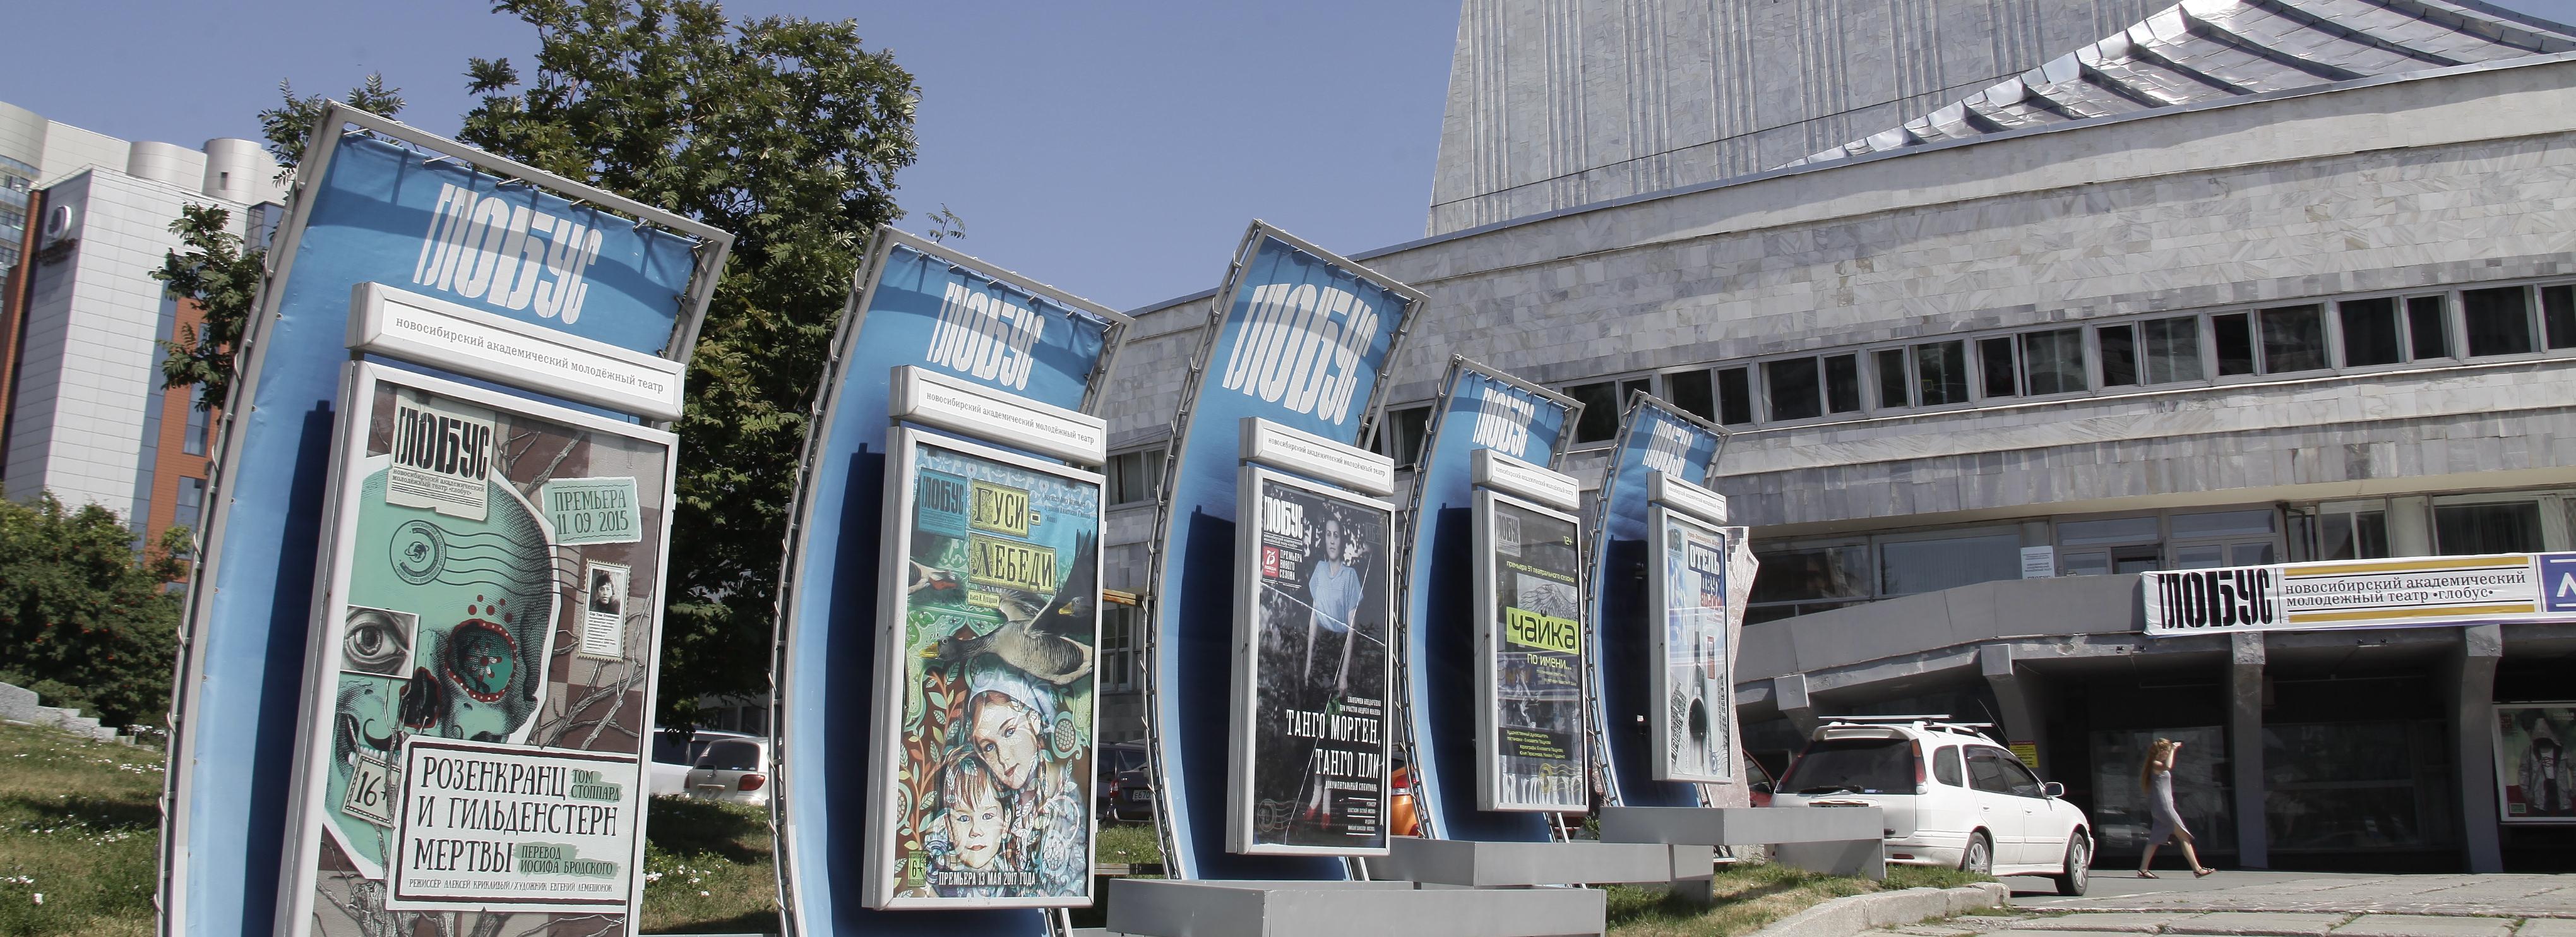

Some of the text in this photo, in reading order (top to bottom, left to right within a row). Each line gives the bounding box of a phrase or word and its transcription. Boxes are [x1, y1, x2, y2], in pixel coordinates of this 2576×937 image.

[413, 182, 602, 325] ГЛОБУС
[926, 282, 1045, 391] ГЛОБУС
[395, 317, 664, 394] новосибирский академический молодёжный театр
[1222, 283, 1378, 426] ГЛОБУС
[926, 392, 1094, 445] новосибирский академический молодёжный театр
[1472, 387, 1535, 457] ГЛОБУС
[395, 407, 490, 480] ГЛОБУС
[393, 469, 484, 492] новосибирский академический
[432, 484, 448, 492] театр
[554, 489, 626, 511] ПРЕМЬЕРА
[922, 476, 964, 515] ГЛОБУС
[557, 510, 628, 534] 11. 09. 2015
[1263, 496, 1303, 539] ГЛОБУС
[973, 542, 1051, 590] ЛЕБЕДИ
[1280, 549, 1303, 563] ПРЕМЬЕРА
[1690, 544, 1720, 575] ОТЕЛЬ
[1279, 569, 1296, 581] СЕЗОНА
[1506, 561, 1527, 571] премьера
[1533, 568, 1560, 579] театрального
[1560, 575, 1574, 583] сезона
[2285, 571, 2525, 594] новосибирский академический
[2157, 568, 2272, 629] ГЛОБУС
[2388, 592, 2428, 603] театр
[1527, 654, 1538, 665] по
[1286, 709, 1380, 747] ТАНГО МОРГЕН,
[573, 770, 593, 784] ТОМ
[1315, 748, 1380, 779] ТАНГО ПЛИ
[421, 756, 566, 800] РОЗЕНКРАНЦ
[571, 785, 619, 801] СТОППАРД
[418, 796, 617, 836] И ГИЛЬДЕНСТЕРН
[414, 838, 513, 873] МЕРТВЫ
[522, 845, 561, 860] ПЕРЕВОД
[521, 860, 612, 874] ИОСИФА БРОДСКОГО
[912, 860, 923, 878] 6+
[939, 871, 1035, 886] ПРЕМЬЕРА 13 МАЯ 2017 ГОДА
[444, 880, 470, 889] АЛЕКСЕЙ
[550, 882, 575, 892] ЕВГЕНИЙ
